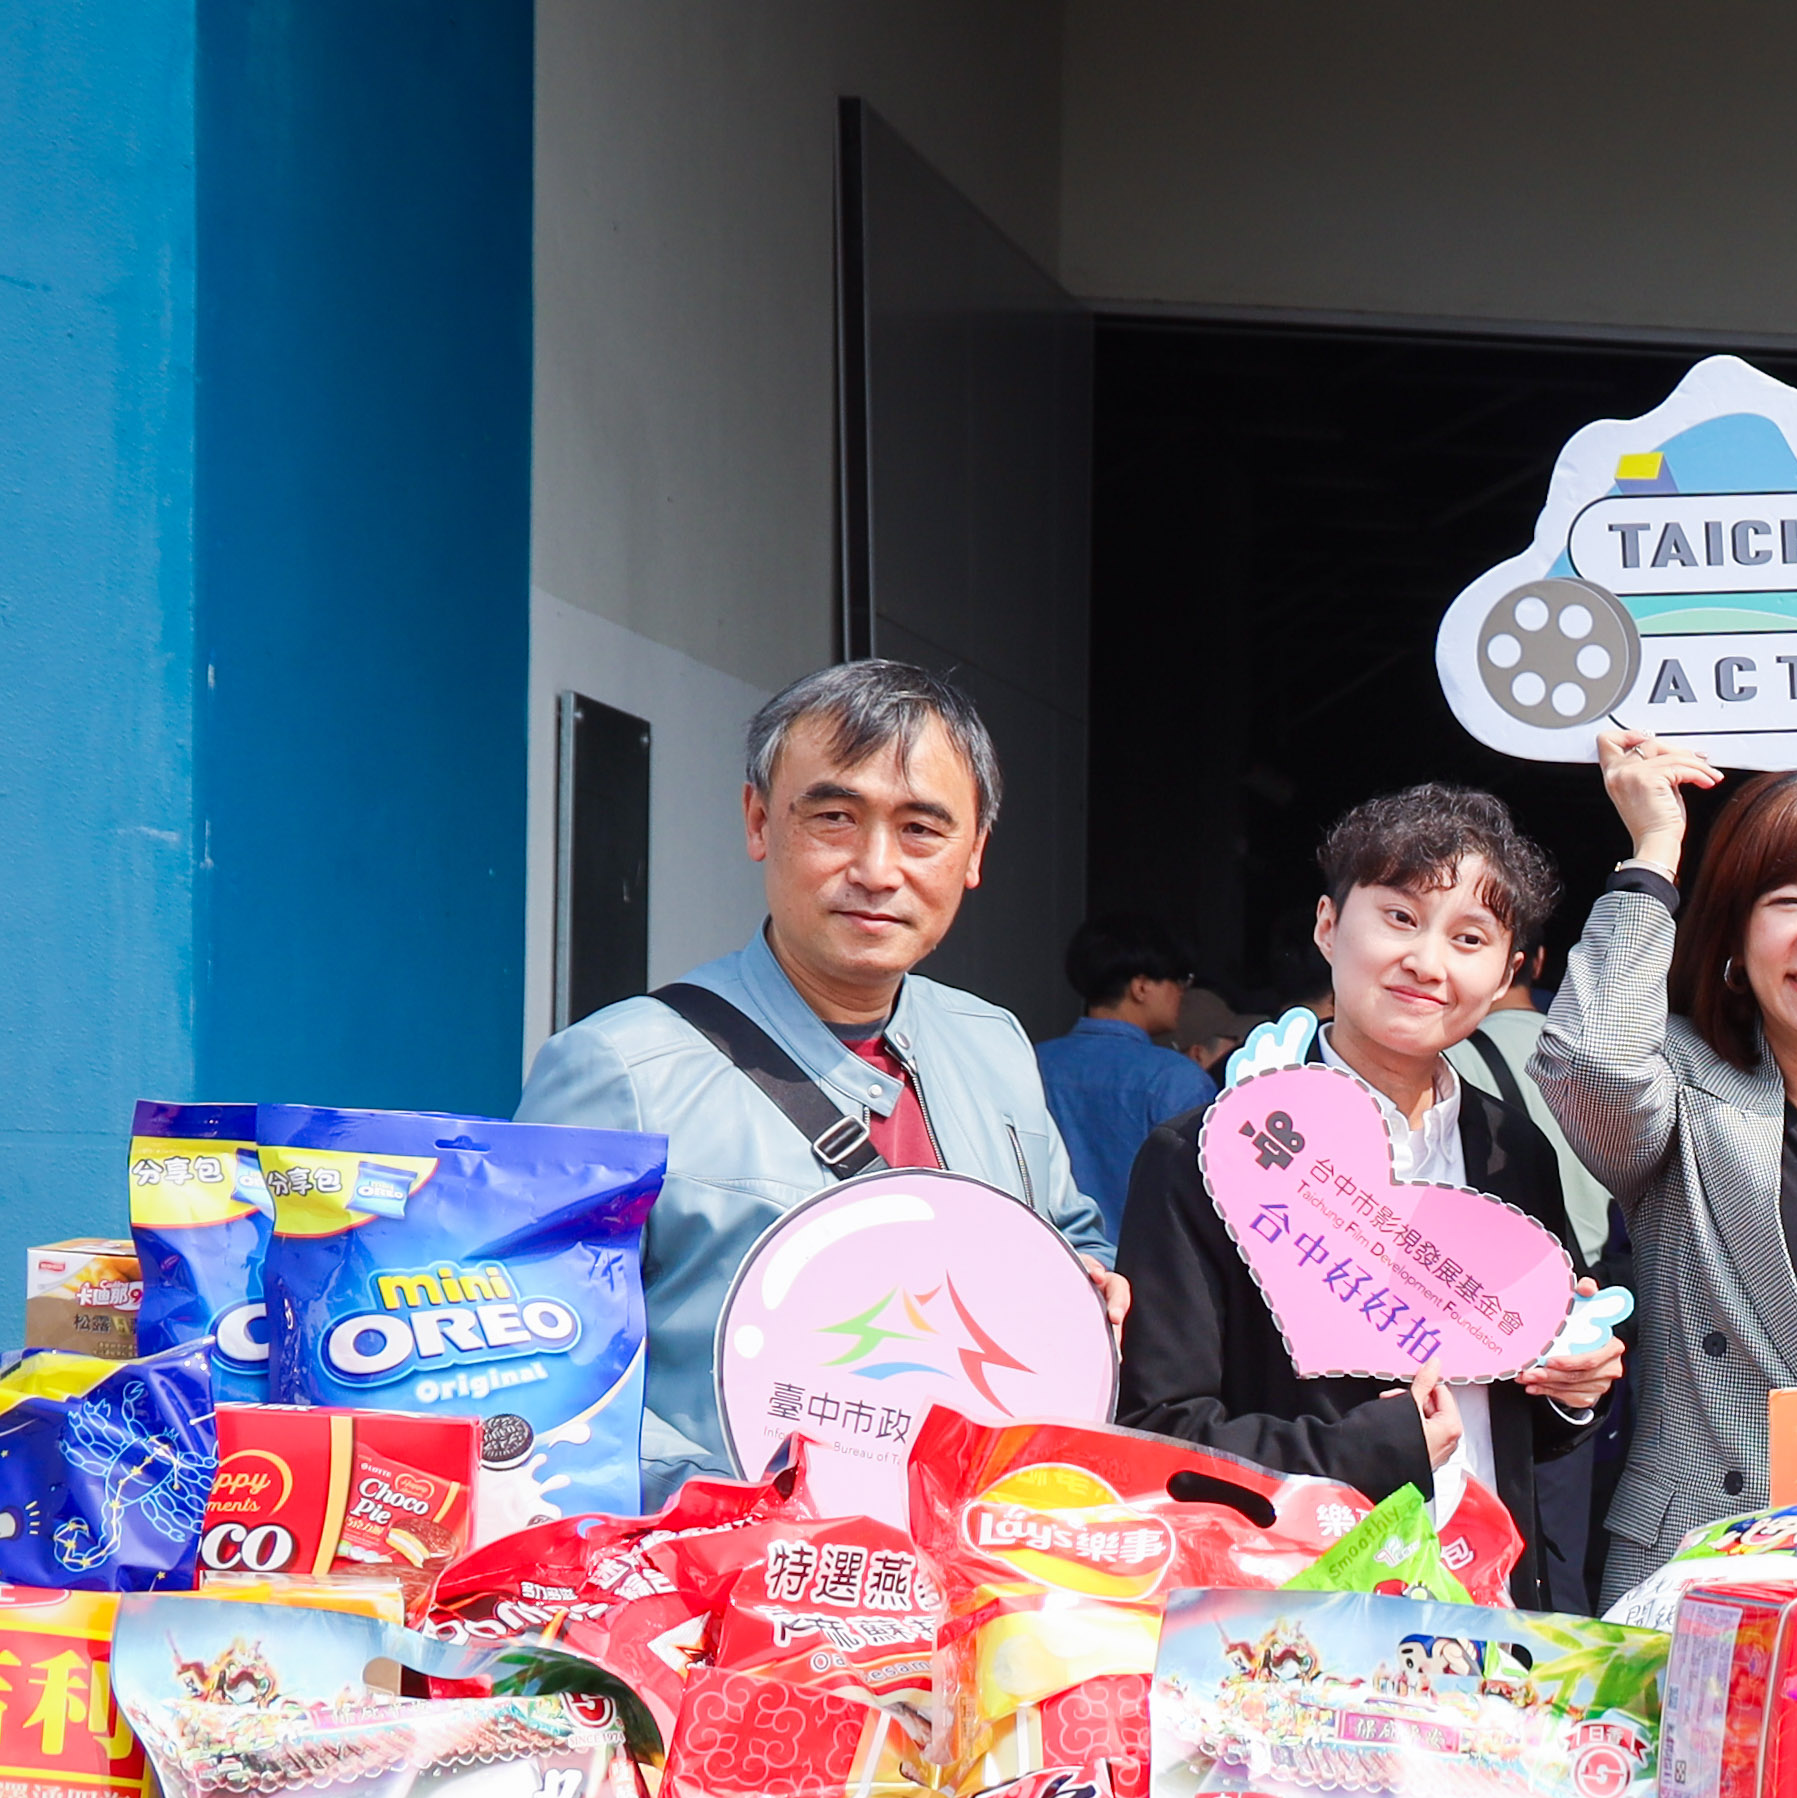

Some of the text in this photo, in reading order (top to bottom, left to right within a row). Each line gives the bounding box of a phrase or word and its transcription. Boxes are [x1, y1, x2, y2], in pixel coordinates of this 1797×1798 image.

[132, 1156, 224, 1186] 分享包
[267, 1166, 343, 1197] 分享包
[1296, 1180, 1503, 1355] Taichung Film Development Foundation
[1310, 1159, 1523, 1335] 台中市影視發展基金會
[378, 1266, 512, 1311] mini
[1250, 1203, 1441, 1364] 台中好好拍
[328, 1301, 576, 1374] OREO
[415, 1362, 548, 1404] Original
[767, 1380, 912, 1444] 臺中市政
[833, 1440, 874, 1460] Bureau
[876, 1450, 888, 1462] of
[350, 1497, 392, 1526] Pie
[358, 1477, 430, 1516] Choco
[978, 1506, 1073, 1550] Lay's
[1075, 1530, 1168, 1565] 樂事
[1328, 1506, 1400, 1580] Smoothly
[767, 1541, 940, 1608] 特選燕
